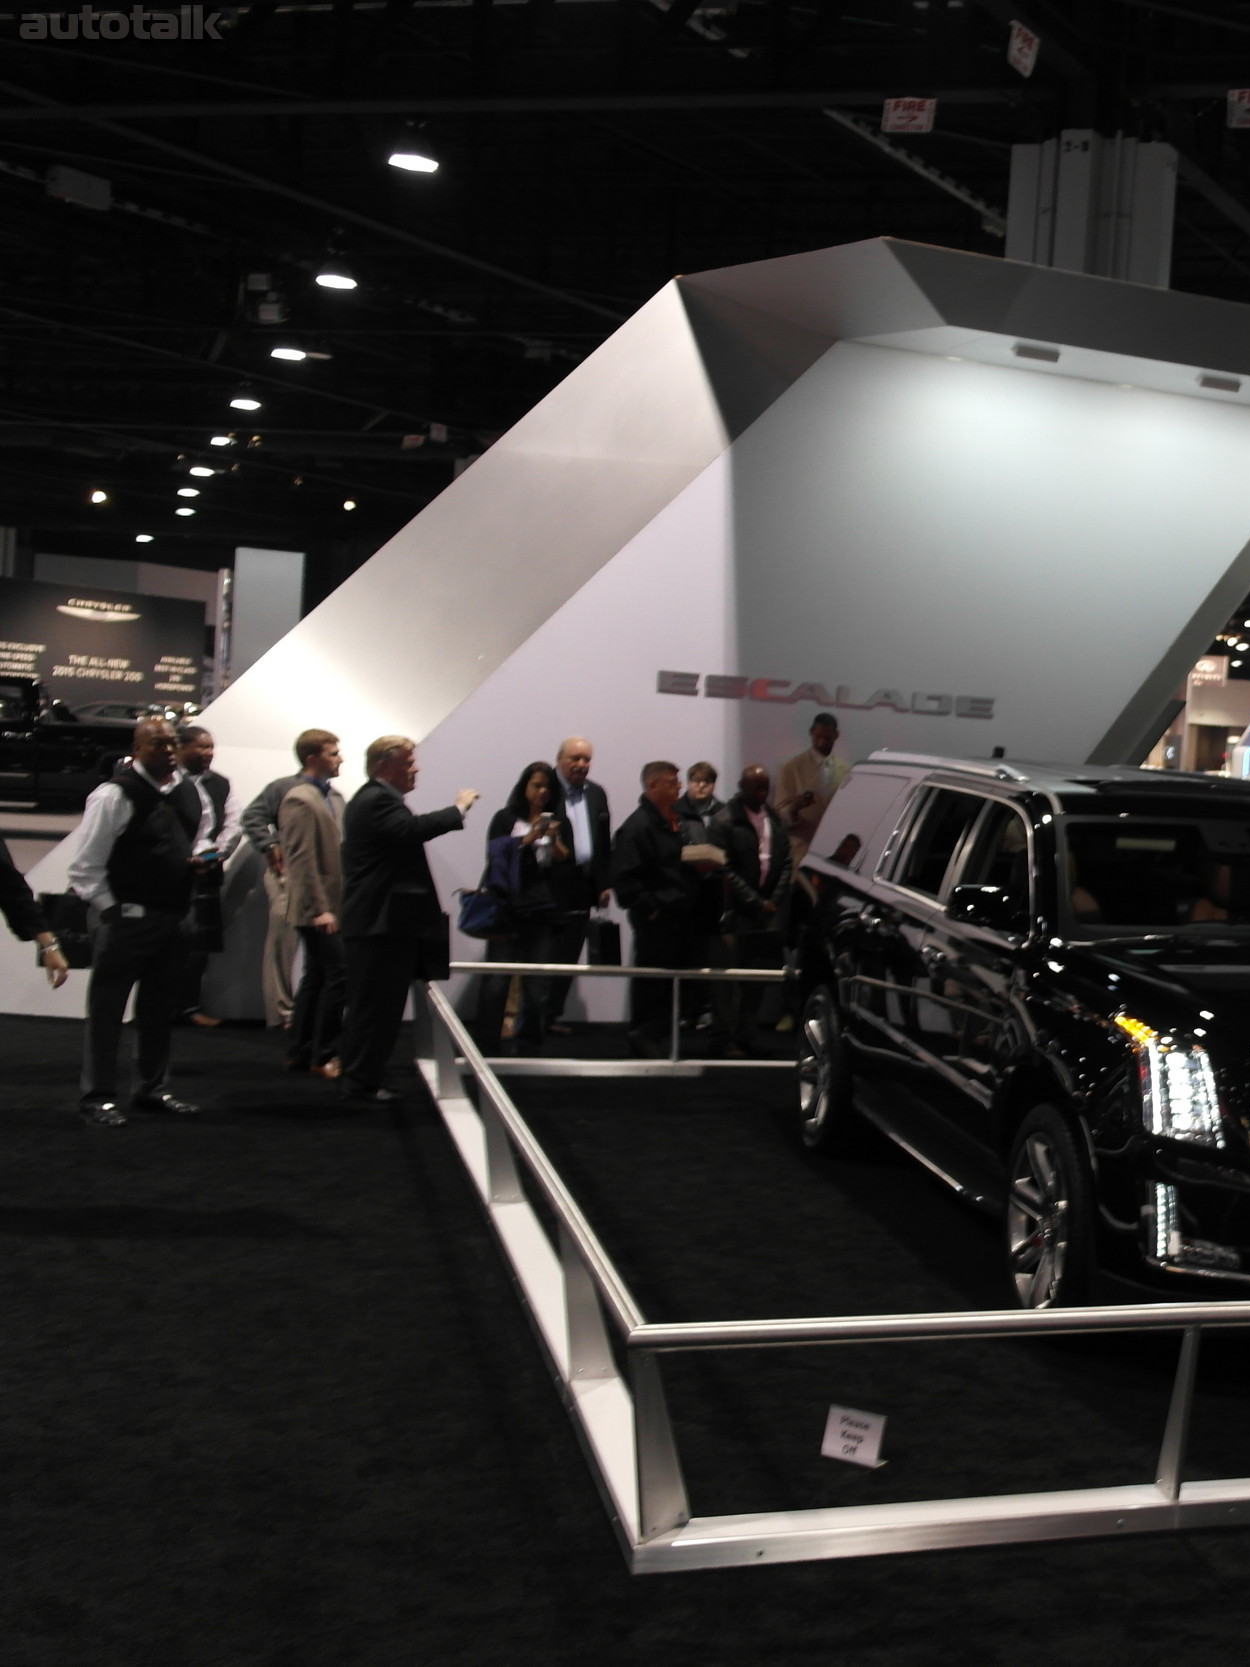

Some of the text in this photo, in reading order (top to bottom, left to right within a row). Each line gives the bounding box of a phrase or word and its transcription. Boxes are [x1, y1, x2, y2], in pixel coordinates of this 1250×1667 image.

[892, 100, 927, 112] FIRE
[68, 654, 131, 670] THE ALL-NEW
[657, 670, 995, 720] ESCALADE
